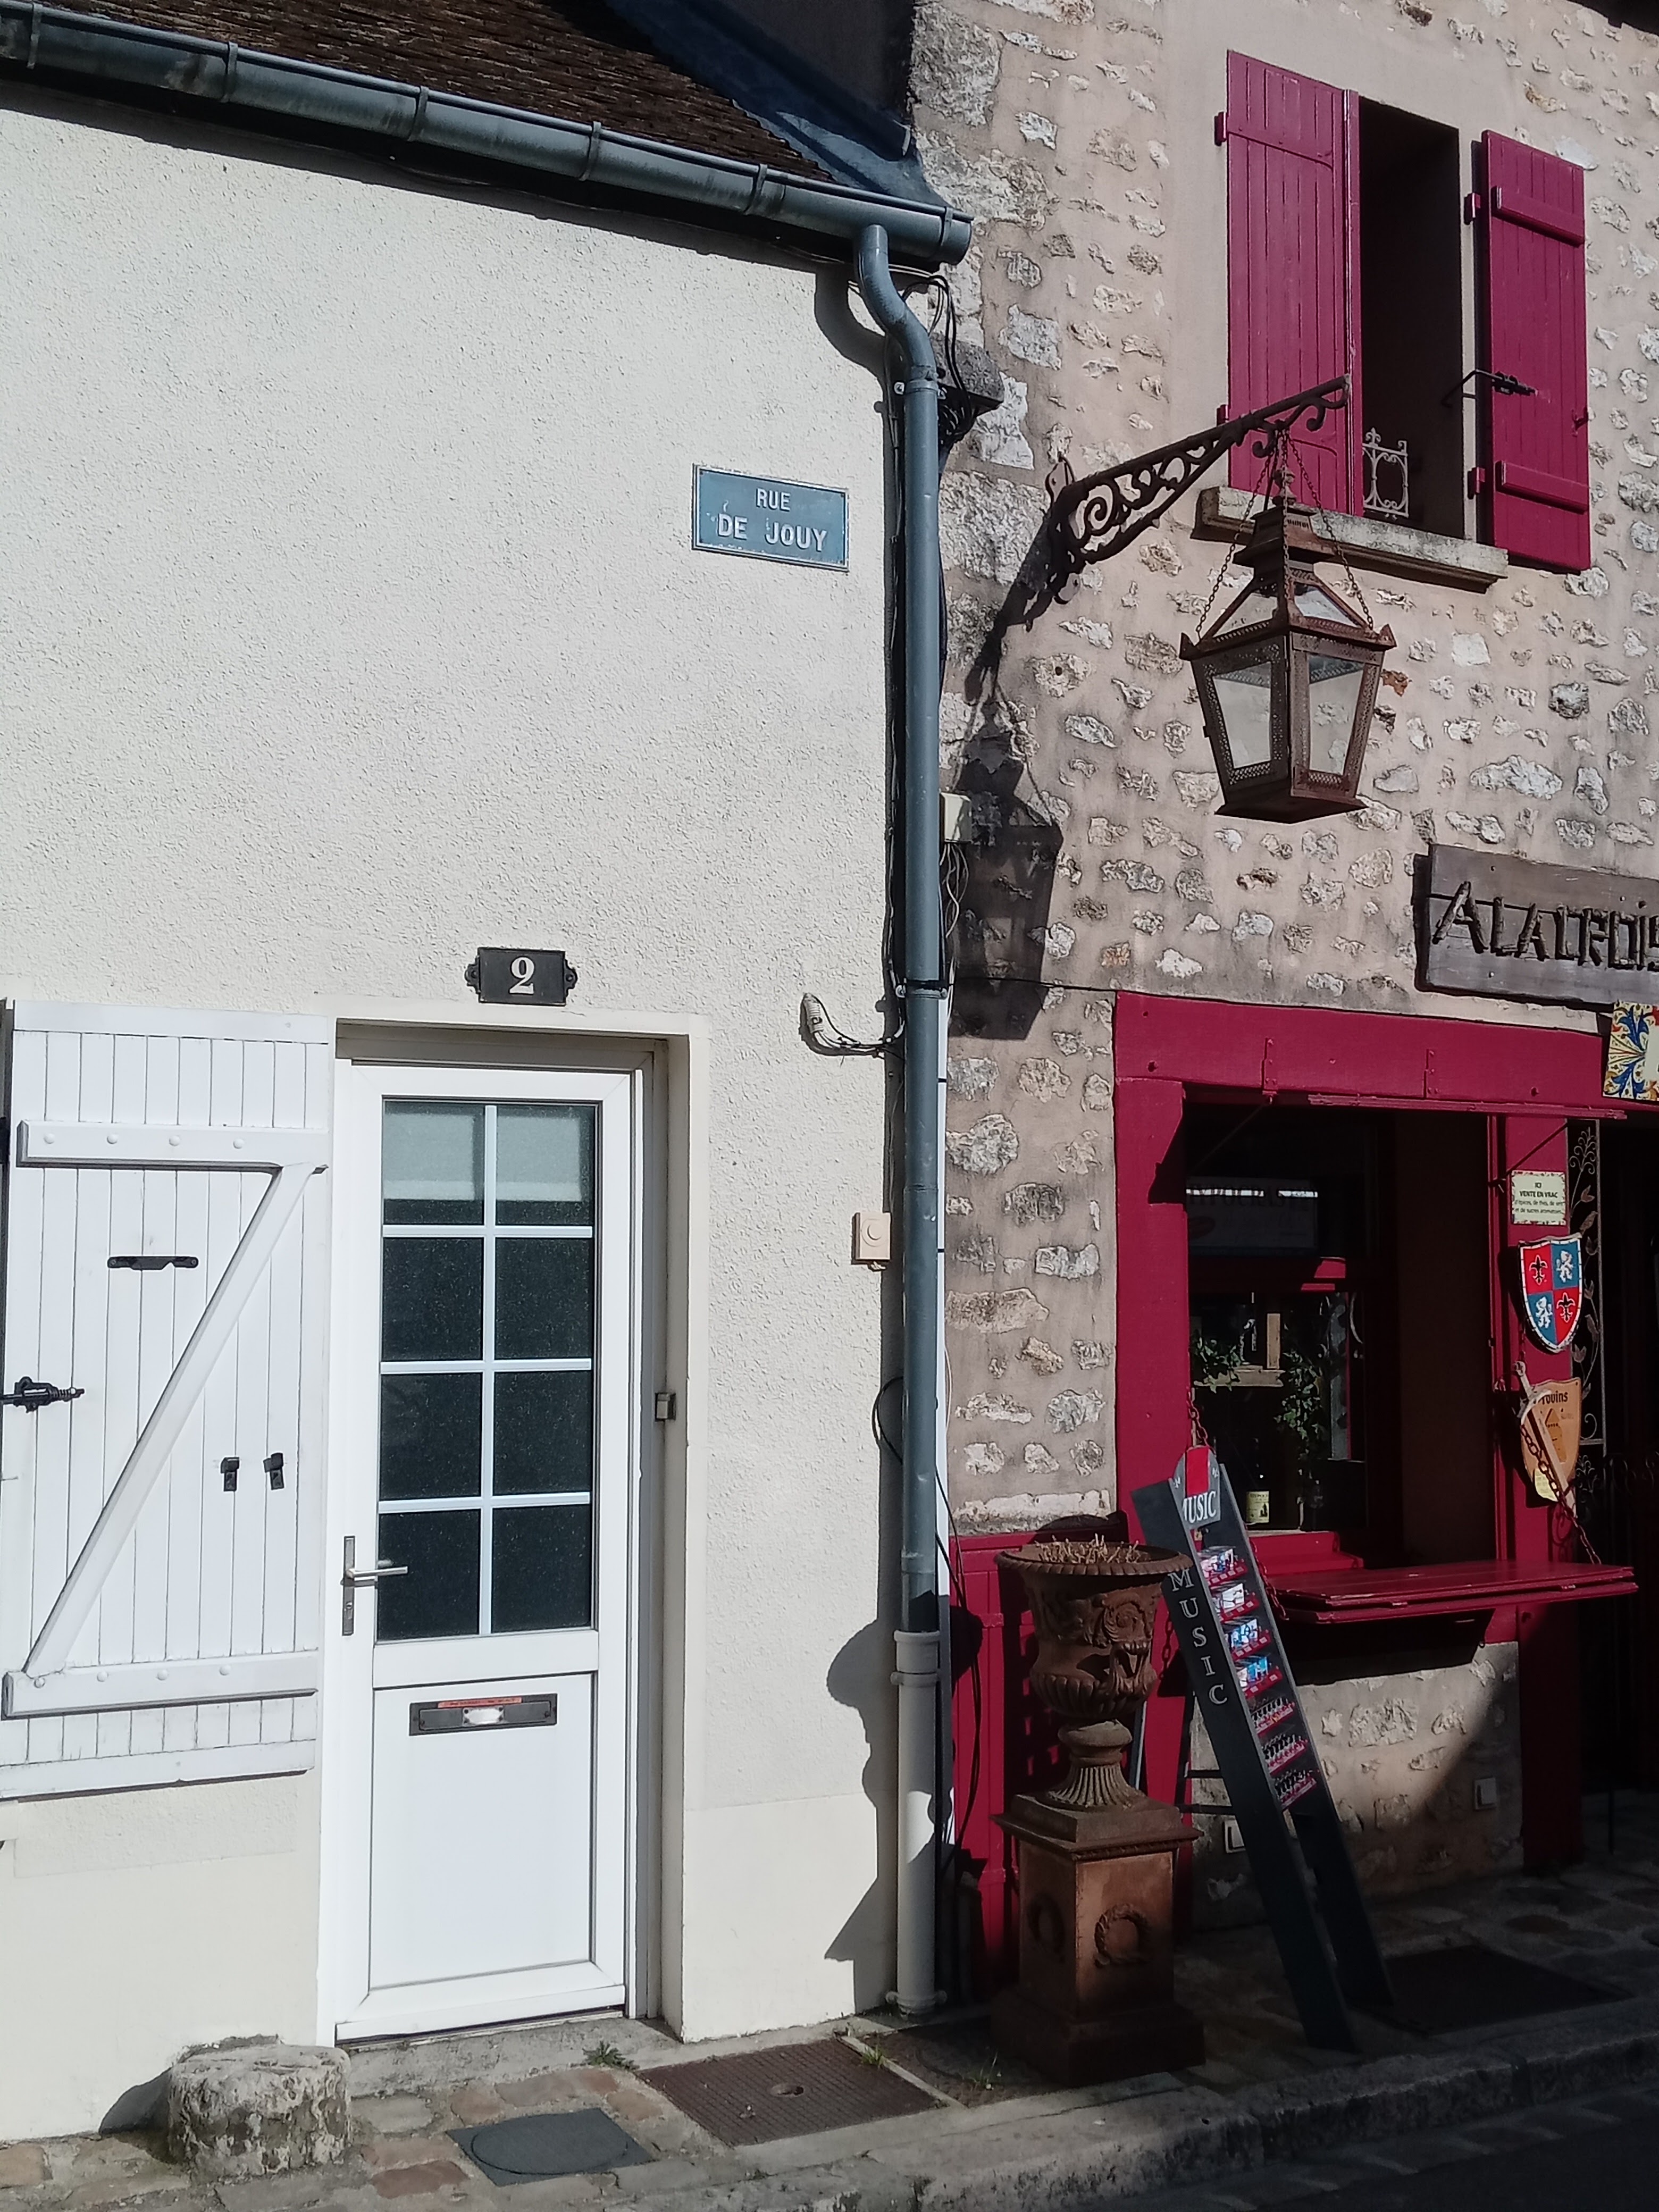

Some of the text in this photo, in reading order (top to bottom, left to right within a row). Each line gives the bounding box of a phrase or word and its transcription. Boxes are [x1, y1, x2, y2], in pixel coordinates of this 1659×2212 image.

[756, 488, 791, 512] RUE
[717, 513, 827, 551] DE JOUY
[508, 957, 535, 994] 2
[1539, 1390, 1569, 1405] rovins
[1168, 1569, 1228, 1705] MUSIC
